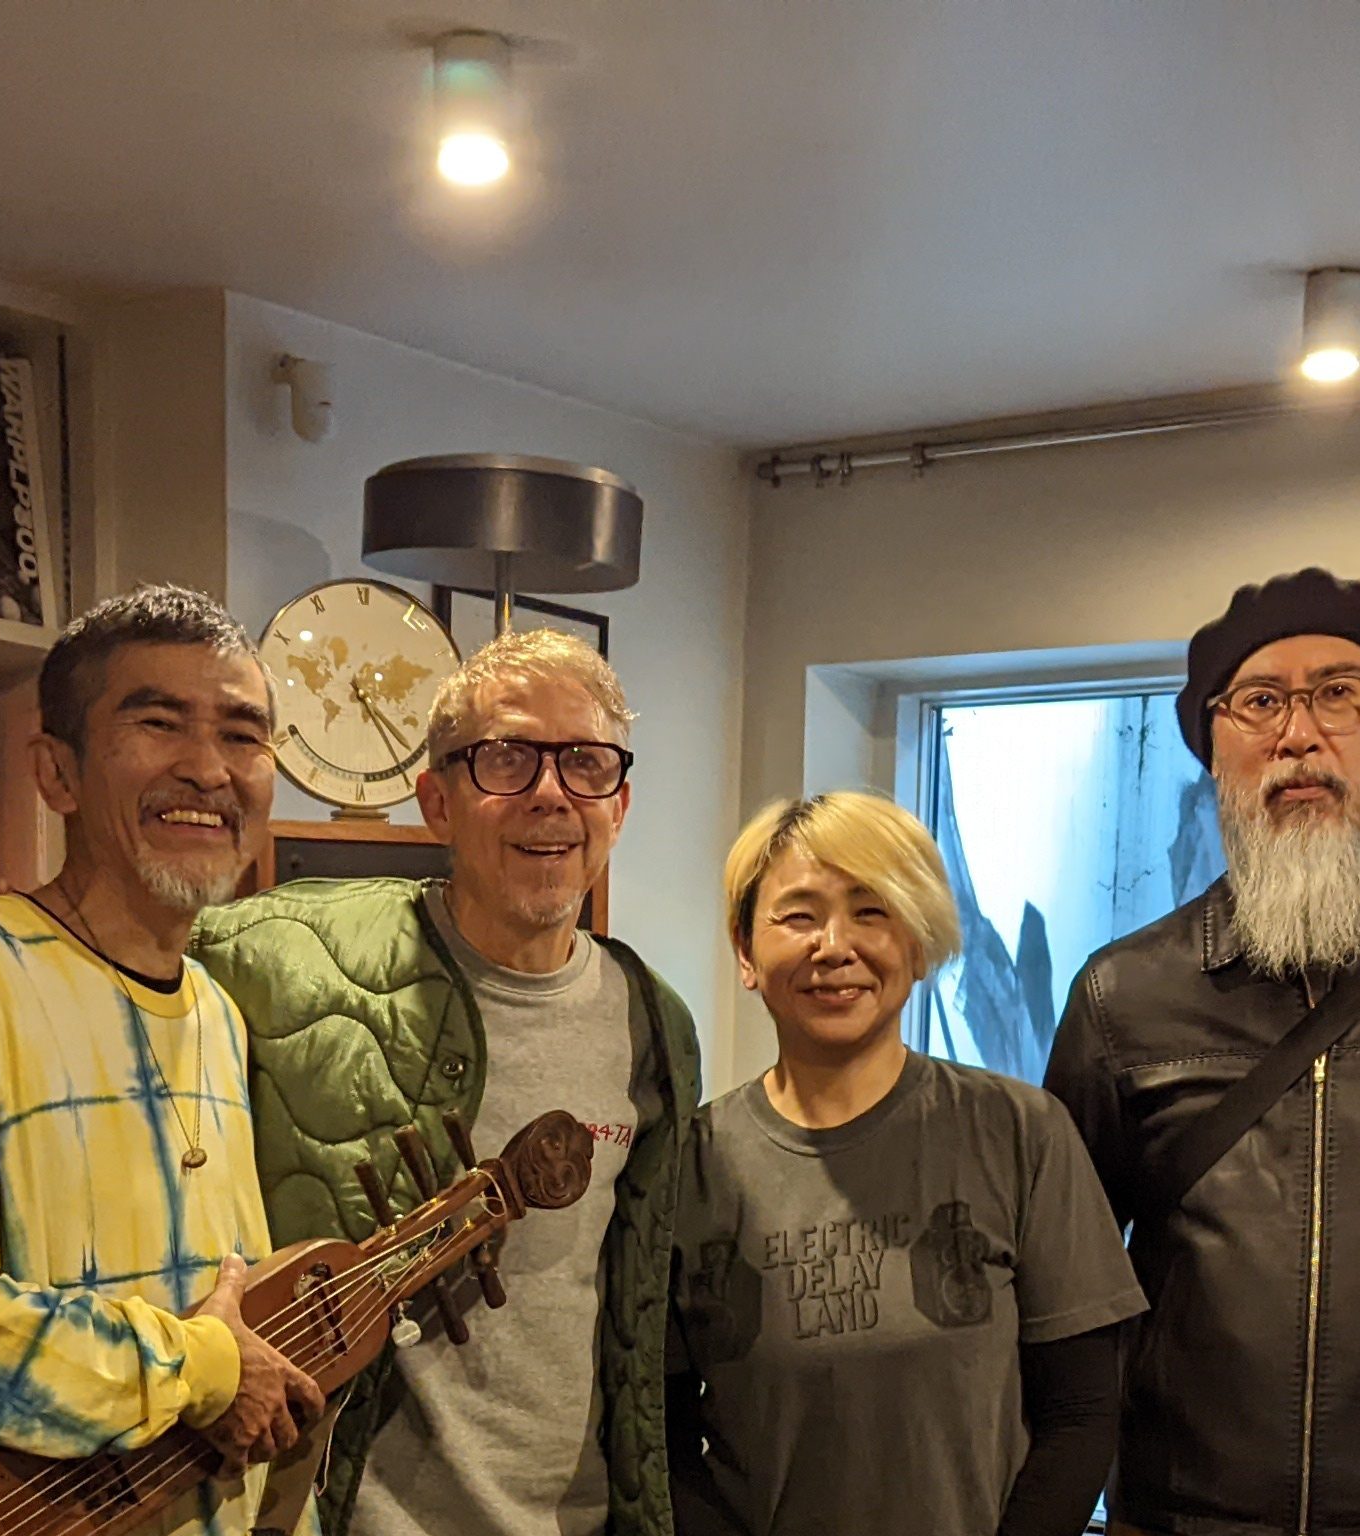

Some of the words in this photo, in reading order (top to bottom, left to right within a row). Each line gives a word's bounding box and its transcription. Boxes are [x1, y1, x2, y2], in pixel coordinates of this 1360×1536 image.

[762, 1214, 910, 1270] ELECTRIC
[788, 1250, 884, 1303] DELAY
[795, 1290, 879, 1339] LAND
